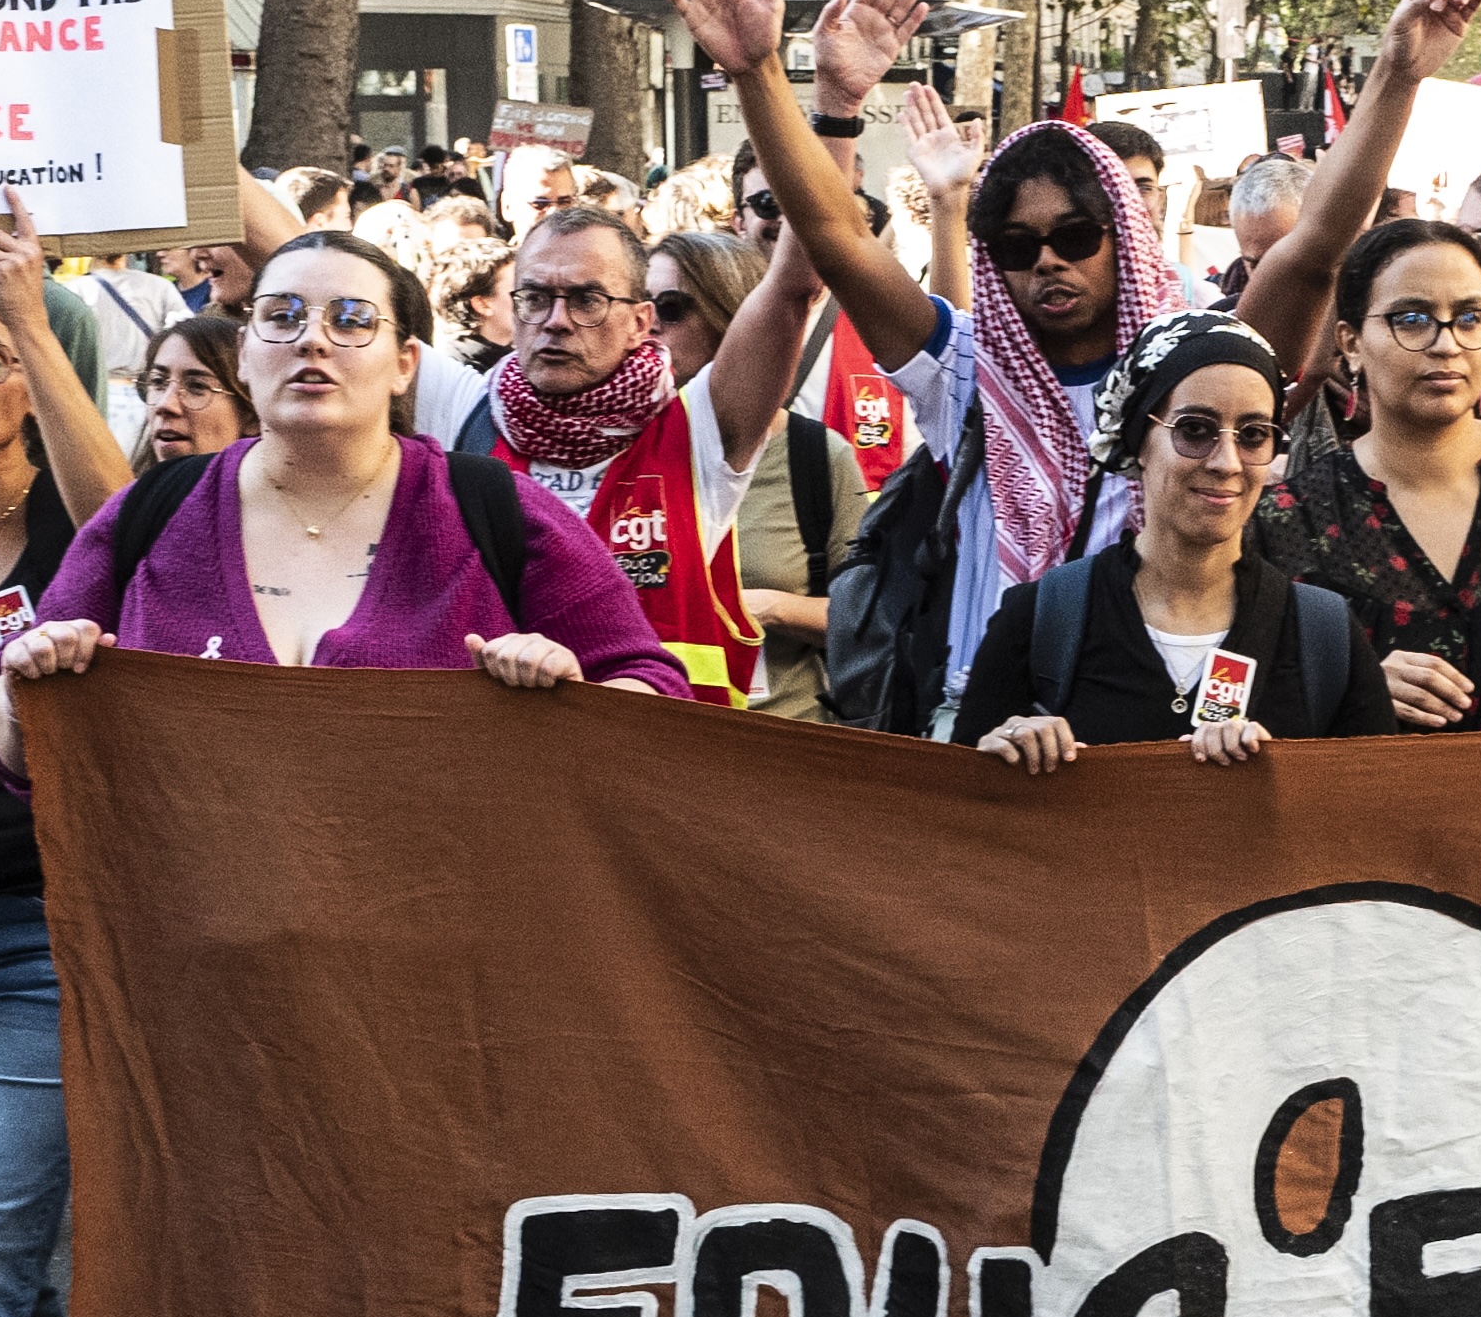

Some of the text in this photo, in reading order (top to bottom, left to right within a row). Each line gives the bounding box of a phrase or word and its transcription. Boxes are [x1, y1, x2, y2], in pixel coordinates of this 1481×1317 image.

[854, 397, 890, 422] cgt
[610, 510, 667, 550] cgt
[1206, 678, 1244, 704] cgt
